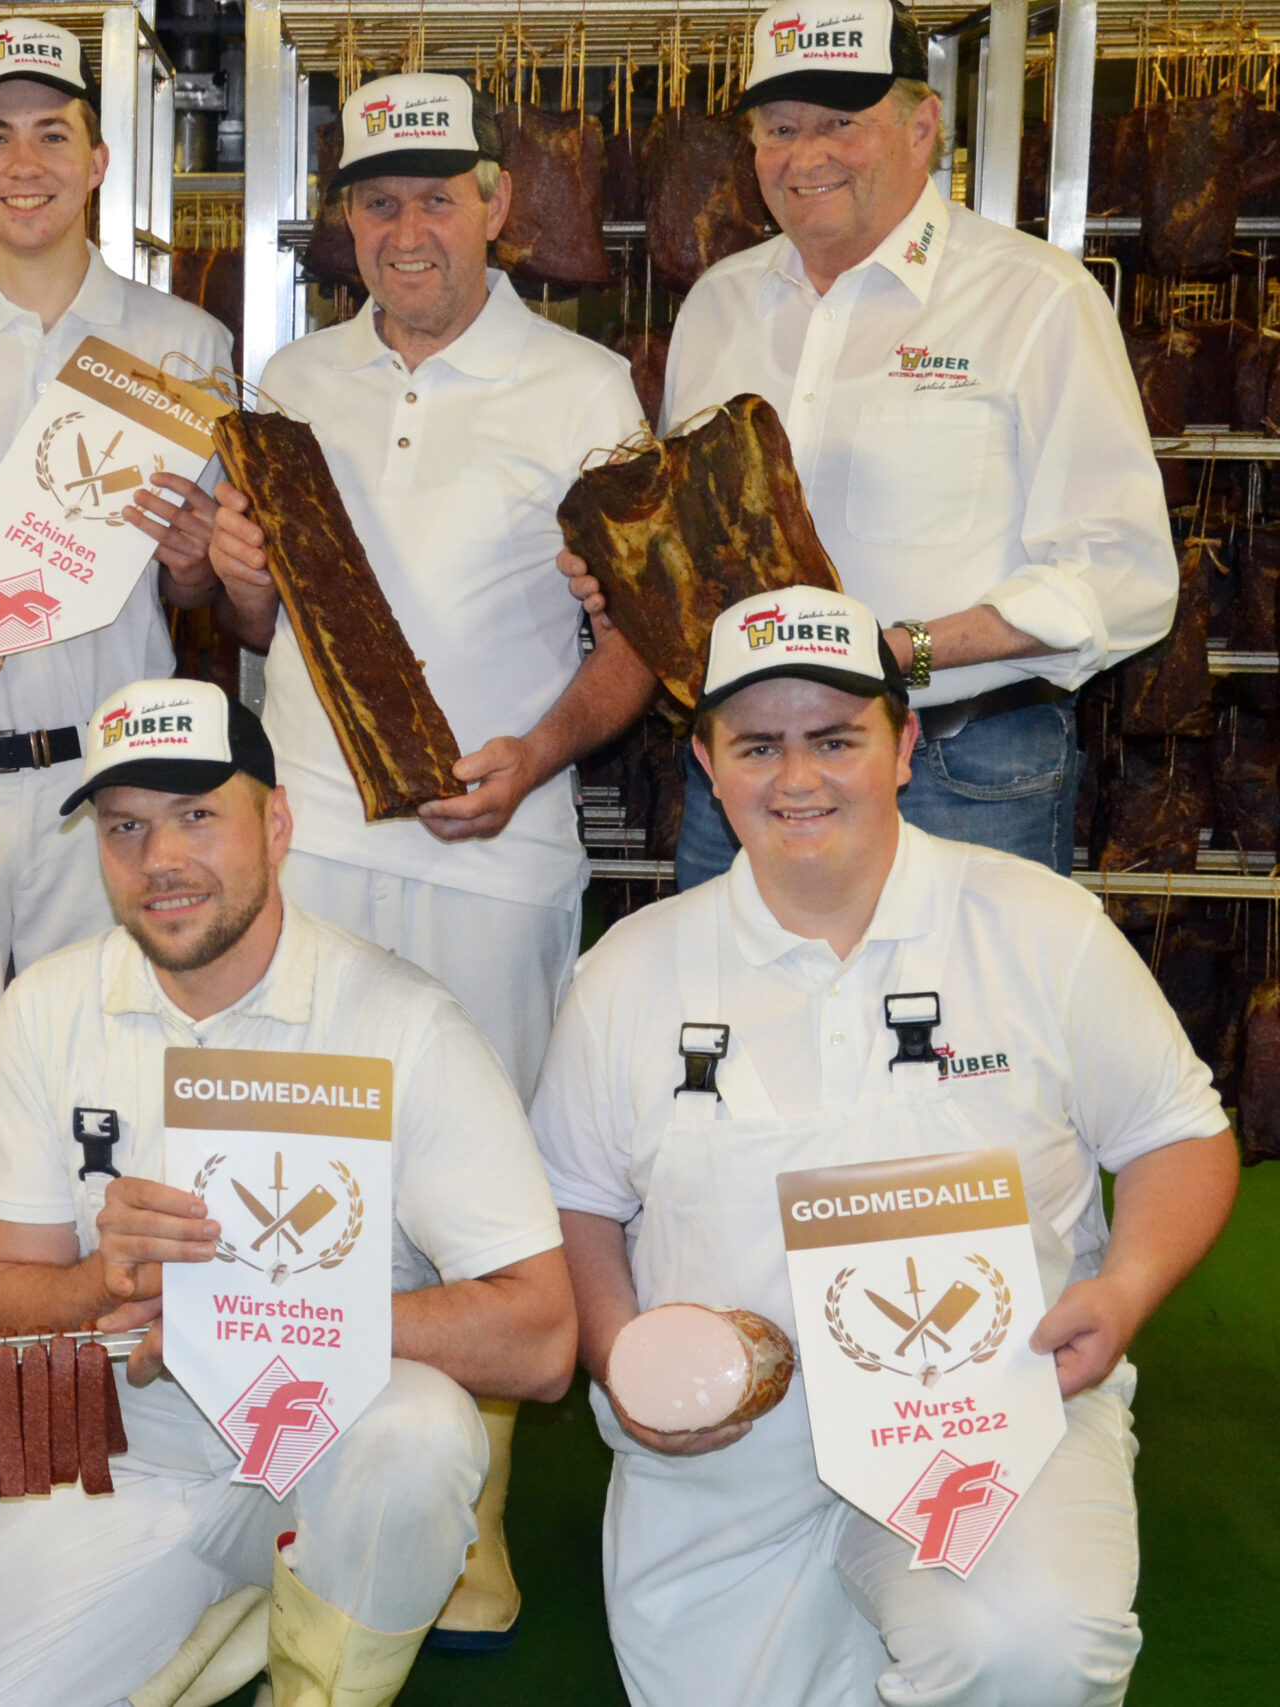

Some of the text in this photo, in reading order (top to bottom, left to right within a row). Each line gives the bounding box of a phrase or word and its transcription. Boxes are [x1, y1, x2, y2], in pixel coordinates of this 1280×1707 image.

[775, 29, 863, 52] HUBER
[366, 110, 450, 134] HUBER
[911, 221, 935, 265] HUBER
[901, 353, 970, 371] HUBER
[21, 511, 97, 563] Schinken
[4, 524, 95, 585] IFFA 2022
[747, 620, 851, 649] HUBER
[103, 715, 193, 746] HUBER
[173, 1077, 381, 1110] GOLDMEDAILLE
[791, 1178, 1012, 1222] GOLDMEDAILLE
[212, 1294, 344, 1323] Würstchen
[216, 1320, 342, 1349] IFFA 2022
[893, 1396, 977, 1421] Wurst
[870, 1412, 1009, 1448] IFFA 2022
